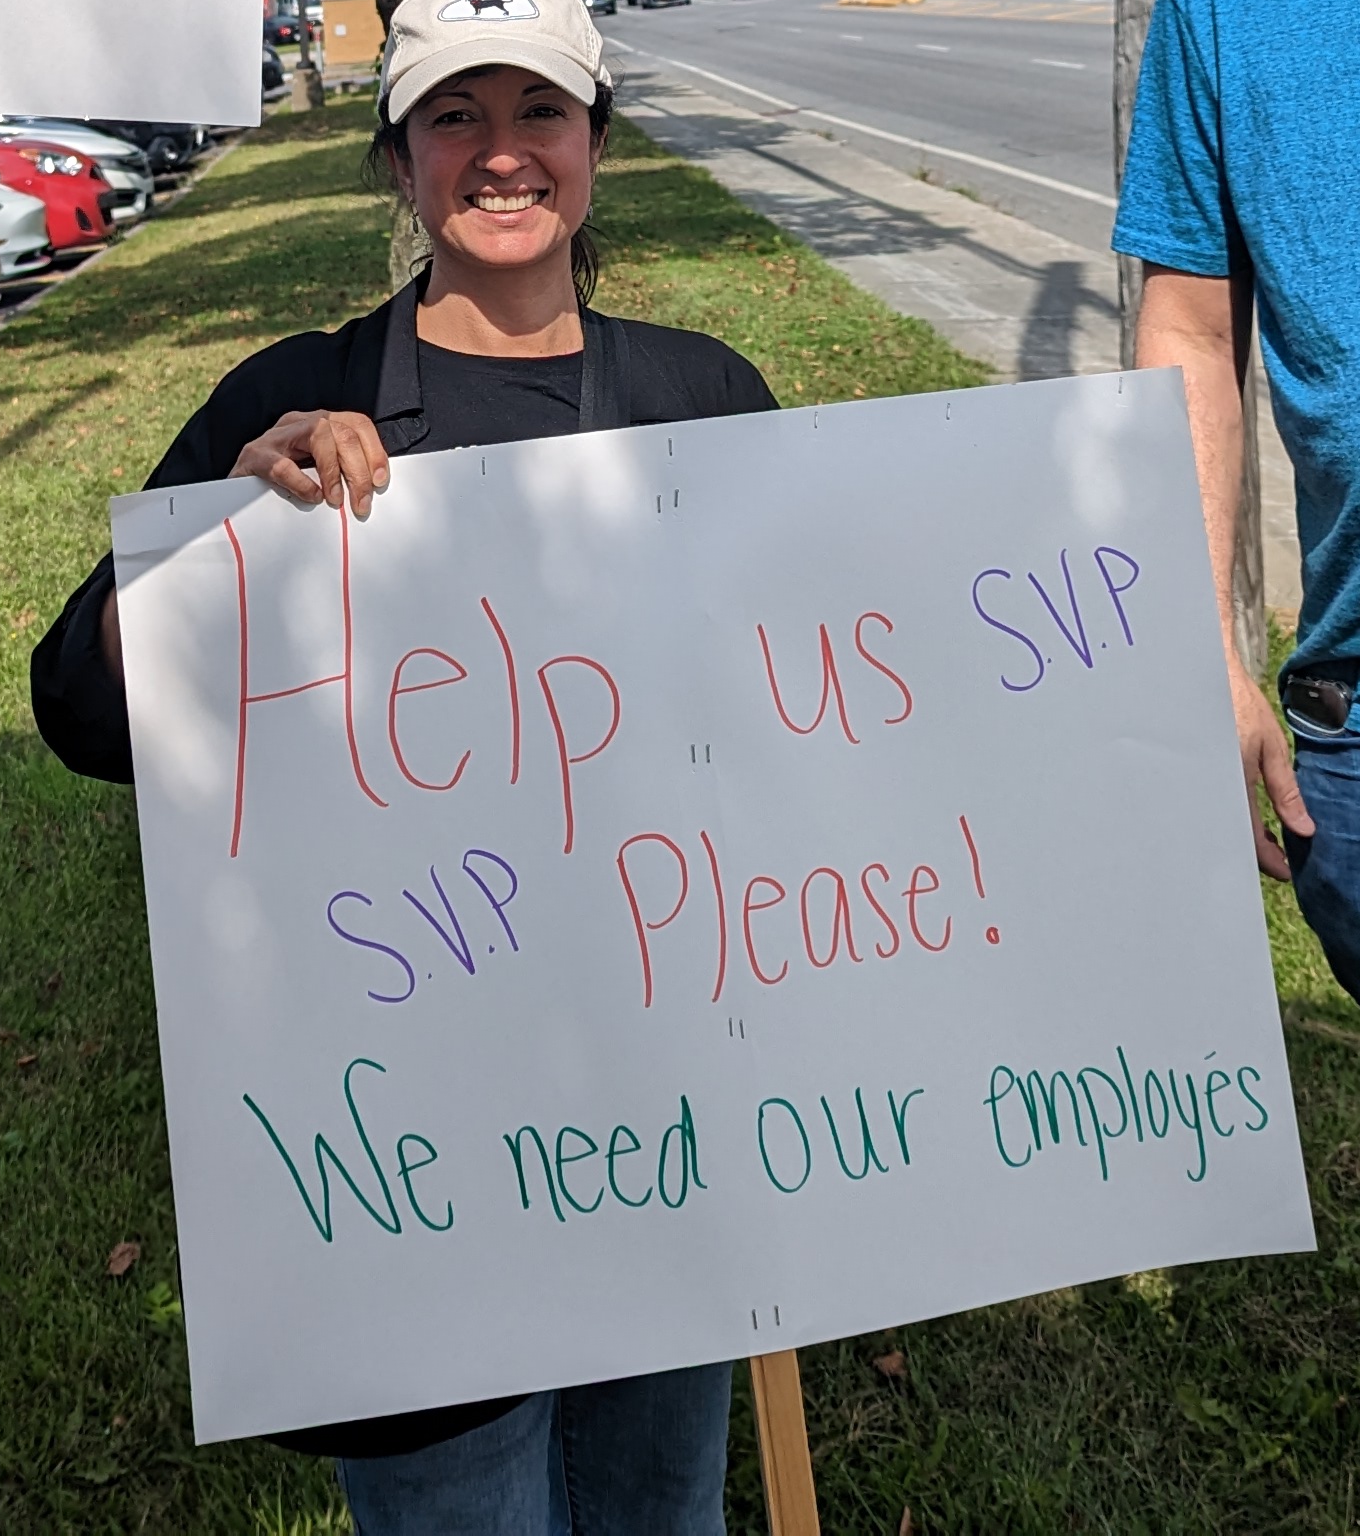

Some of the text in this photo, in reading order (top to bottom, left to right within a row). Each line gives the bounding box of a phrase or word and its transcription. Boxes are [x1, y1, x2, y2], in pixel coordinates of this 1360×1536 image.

[224, 506, 623, 859] Help
[758, 612, 913, 745] us
[617, 816, 1002, 1007] Please!
[243, 1058, 455, 1242] We
[503, 1096, 708, 1223] need
[757, 1082, 926, 1194] our
